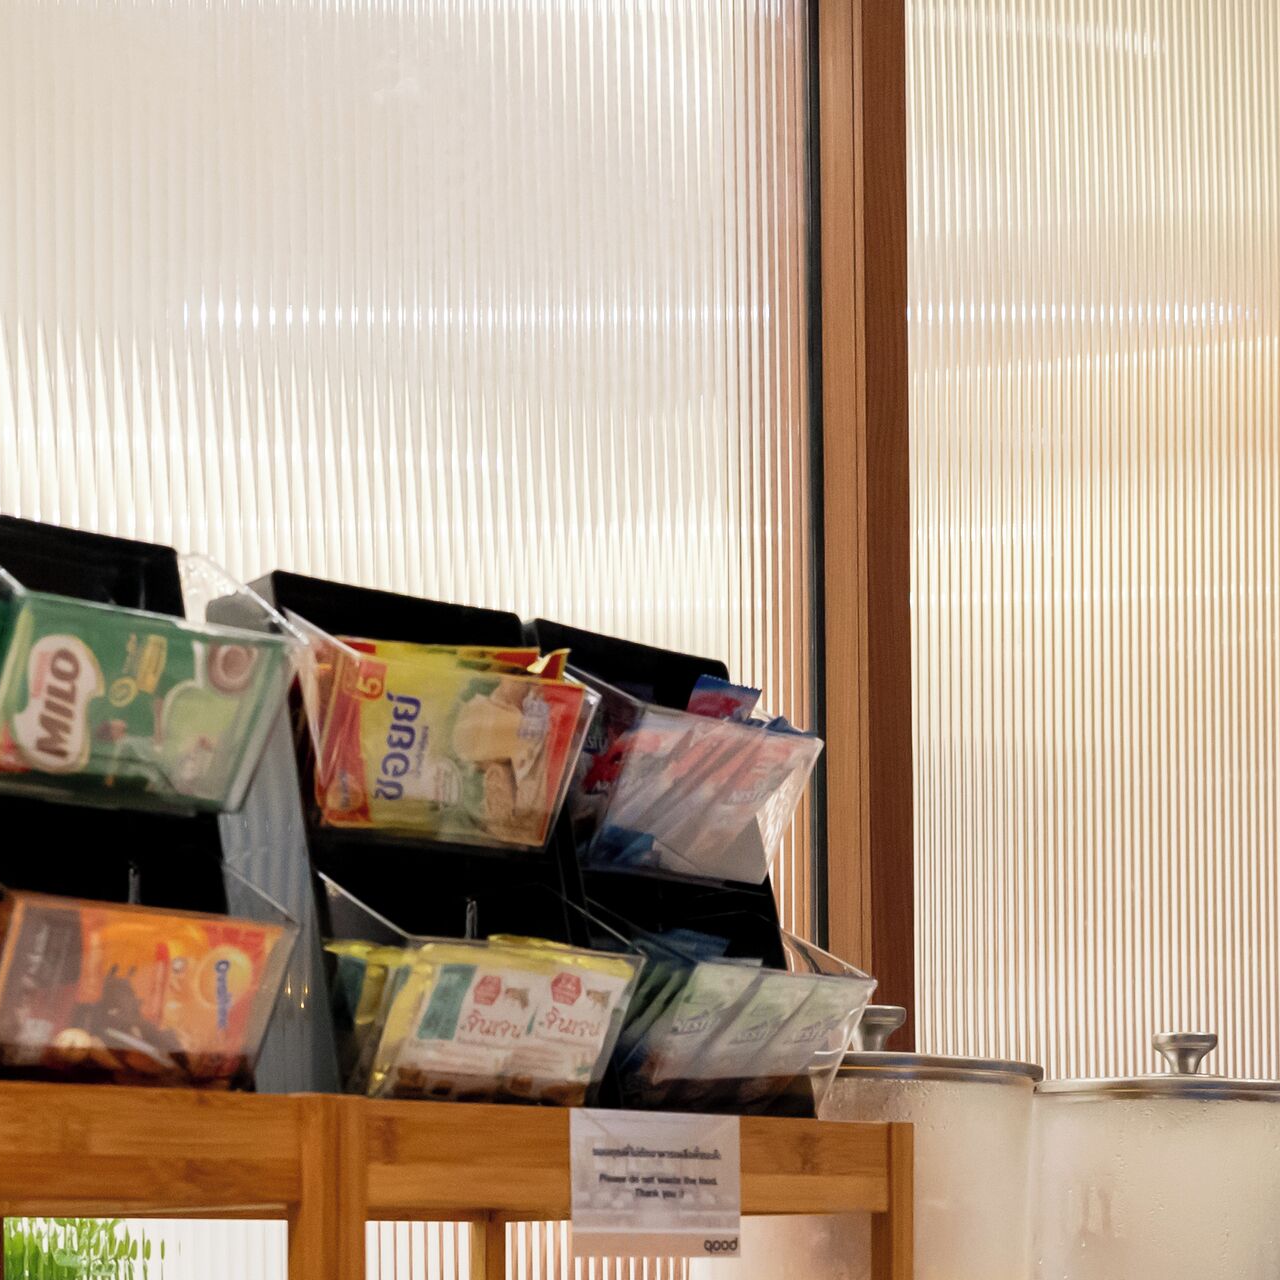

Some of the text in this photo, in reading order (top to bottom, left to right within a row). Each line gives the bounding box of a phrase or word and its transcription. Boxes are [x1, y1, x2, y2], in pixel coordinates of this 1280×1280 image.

[35, 648, 81, 760] MILO
[599, 1173, 626, 1183] Please
[629, 1175, 639, 1184] do
[641, 1176, 655, 1184] not
[683, 1176, 697, 1185] the
[635, 1187, 659, 1198] Thank
[662, 1189, 676, 1199] you
